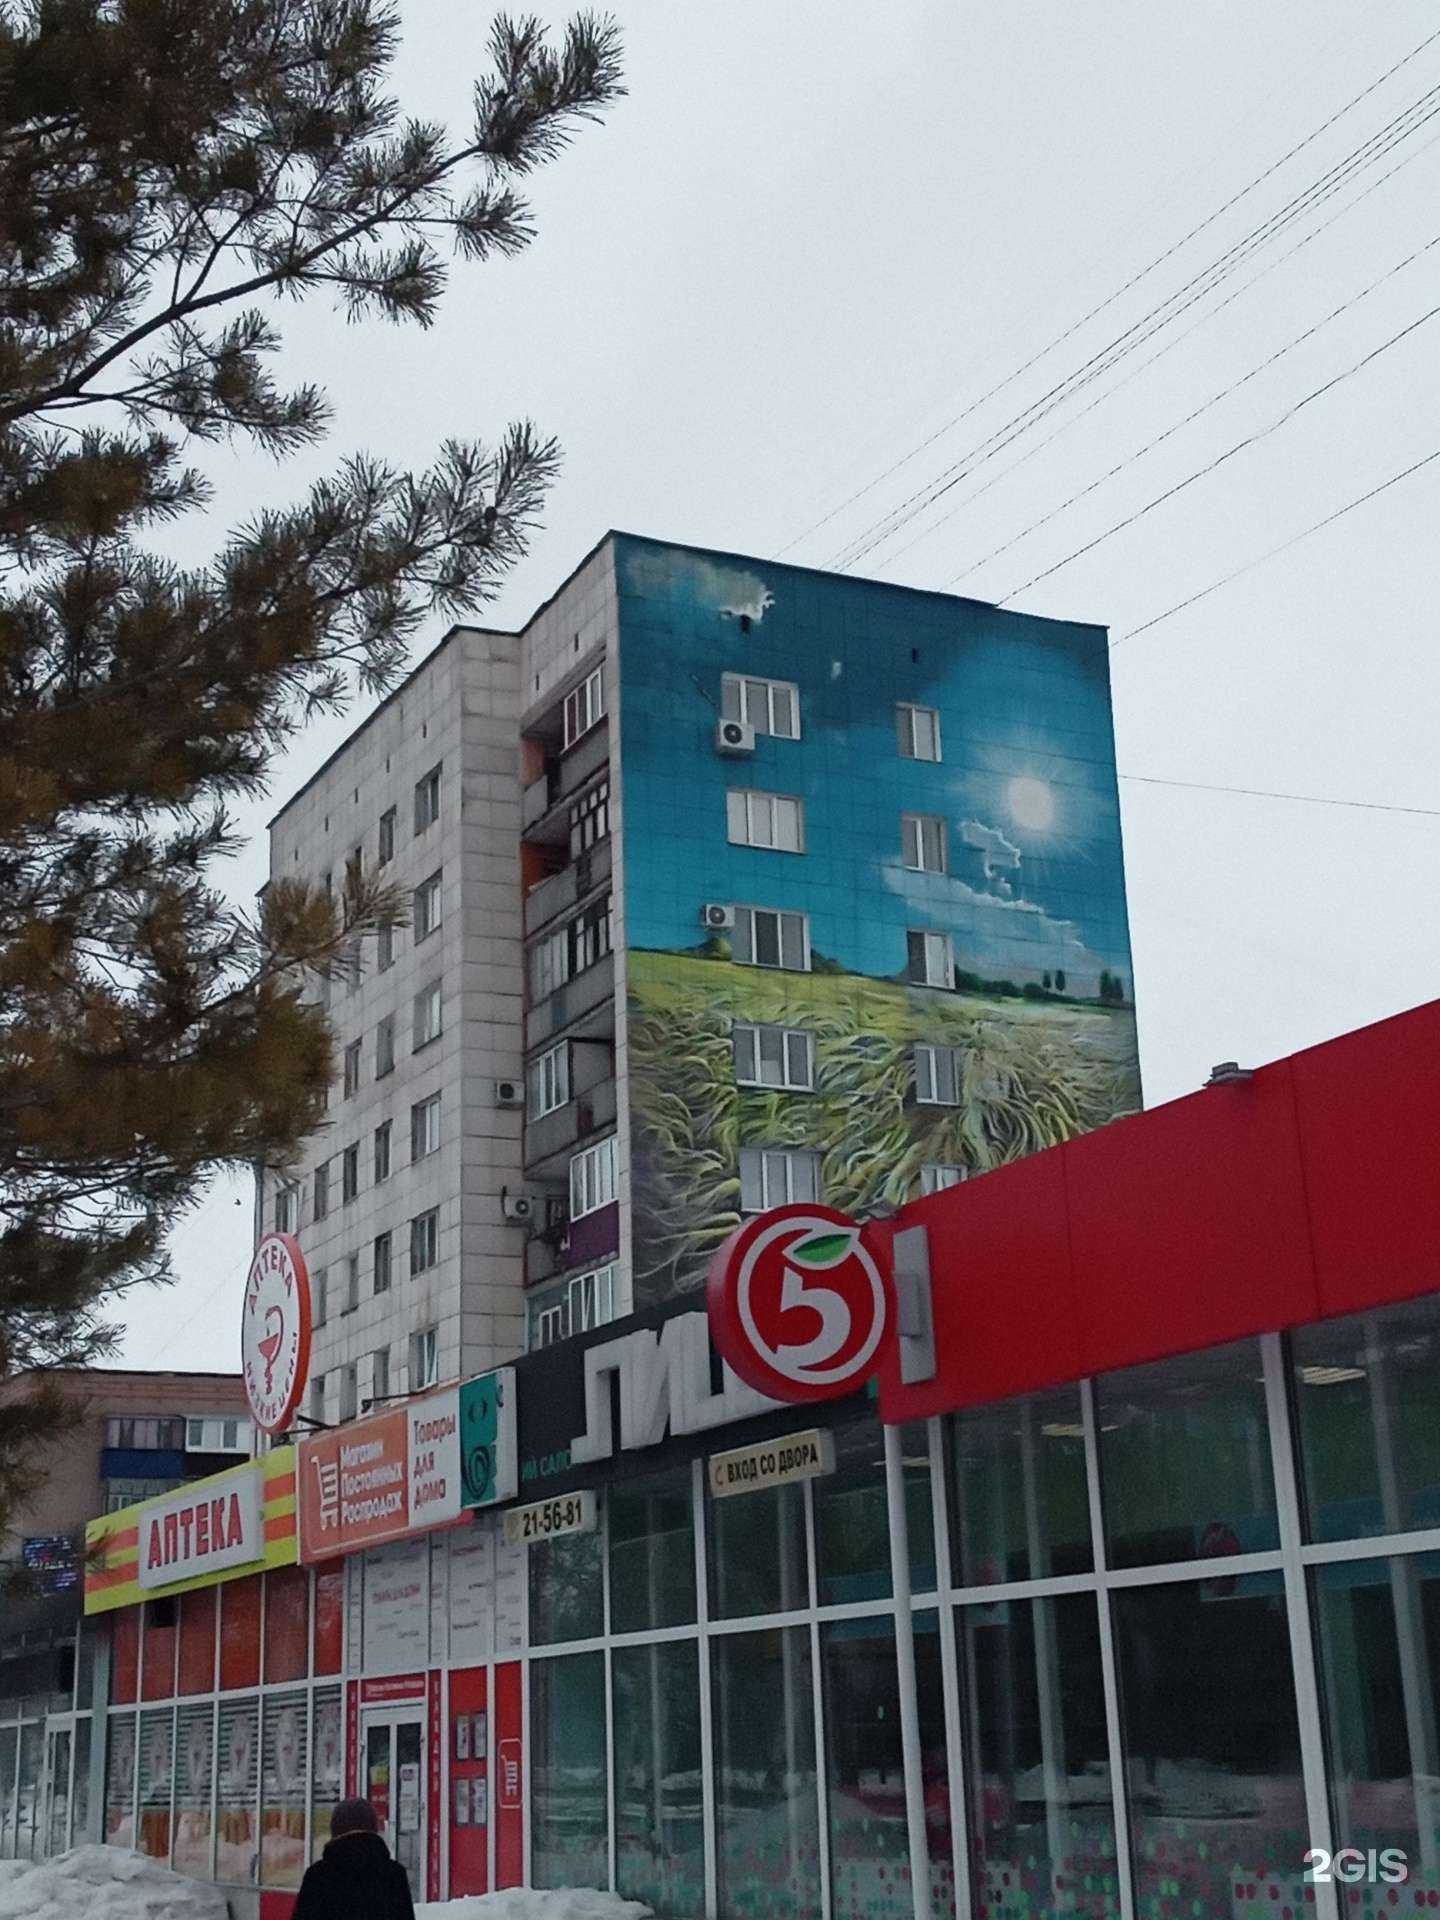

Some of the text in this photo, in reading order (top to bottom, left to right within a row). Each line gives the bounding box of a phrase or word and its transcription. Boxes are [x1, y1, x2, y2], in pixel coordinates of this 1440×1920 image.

[249, 1245, 292, 1315] АПТЕКА
[775, 1264, 851, 1370] 5
[727, 1443, 818, 1482] ВХОД СО ДВОРА
[148, 1493, 243, 1570] АПТЕКА
[523, 1500, 582, 1537] 21-56-81
